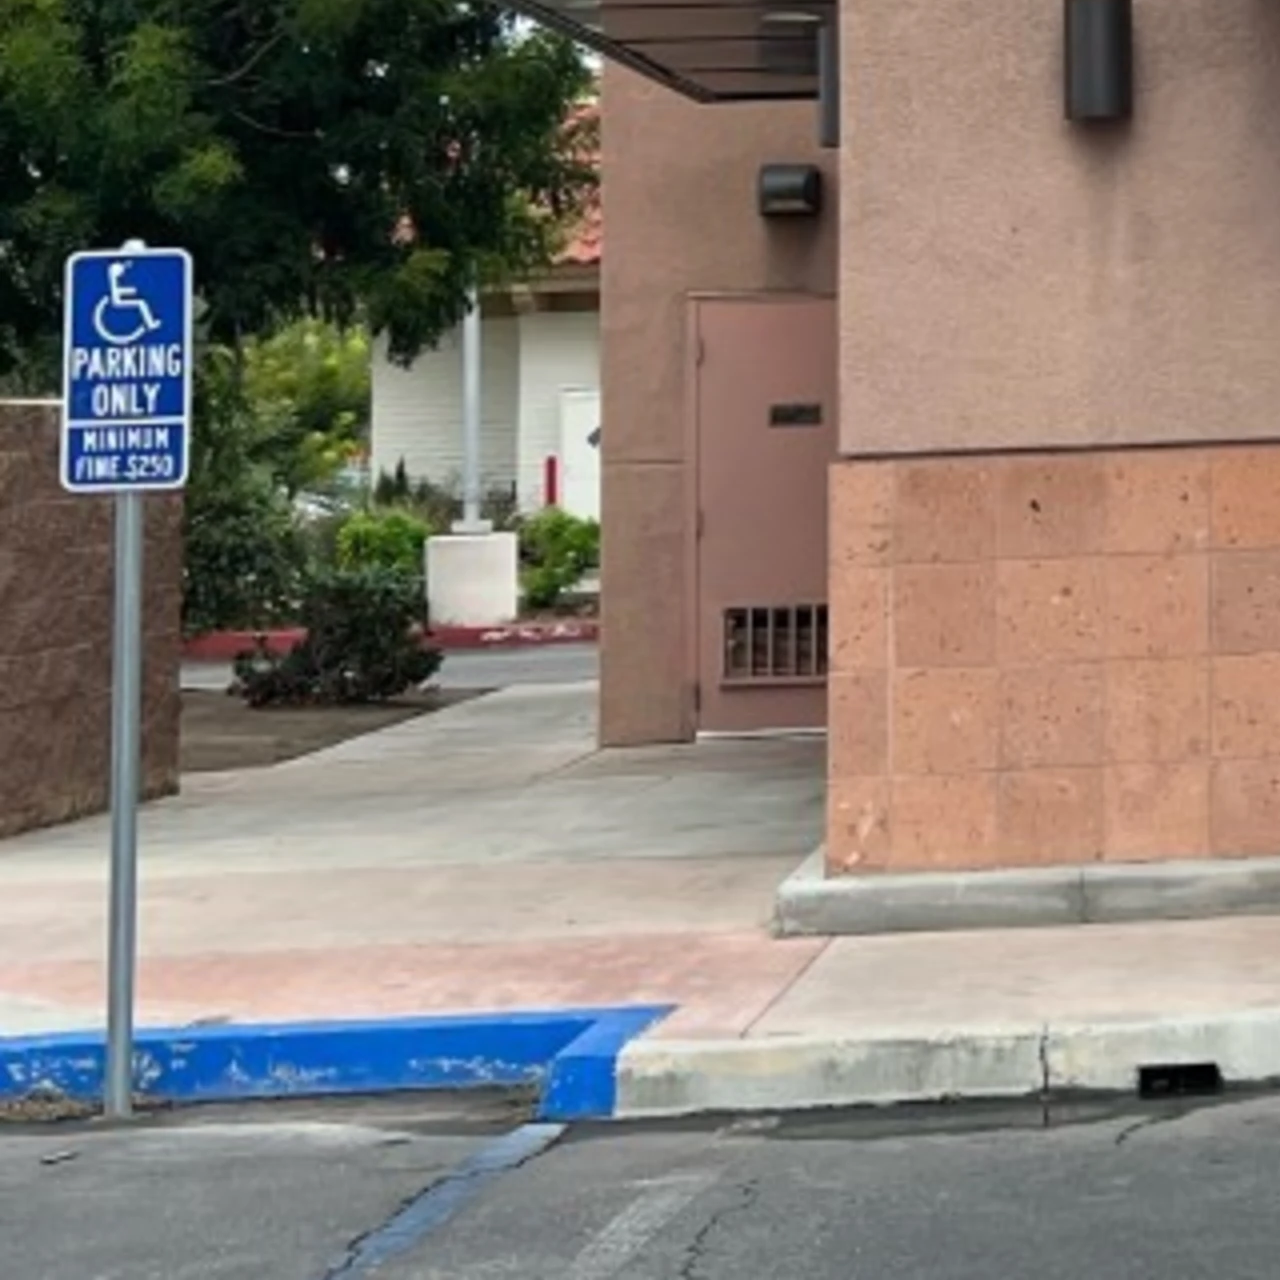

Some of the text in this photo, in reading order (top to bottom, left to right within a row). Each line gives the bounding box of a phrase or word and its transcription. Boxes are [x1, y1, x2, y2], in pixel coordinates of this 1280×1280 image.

[73, 344, 182, 380] PARKING
[91, 382, 161, 417] ONLY
[83, 427, 169, 452] MINIMUM
